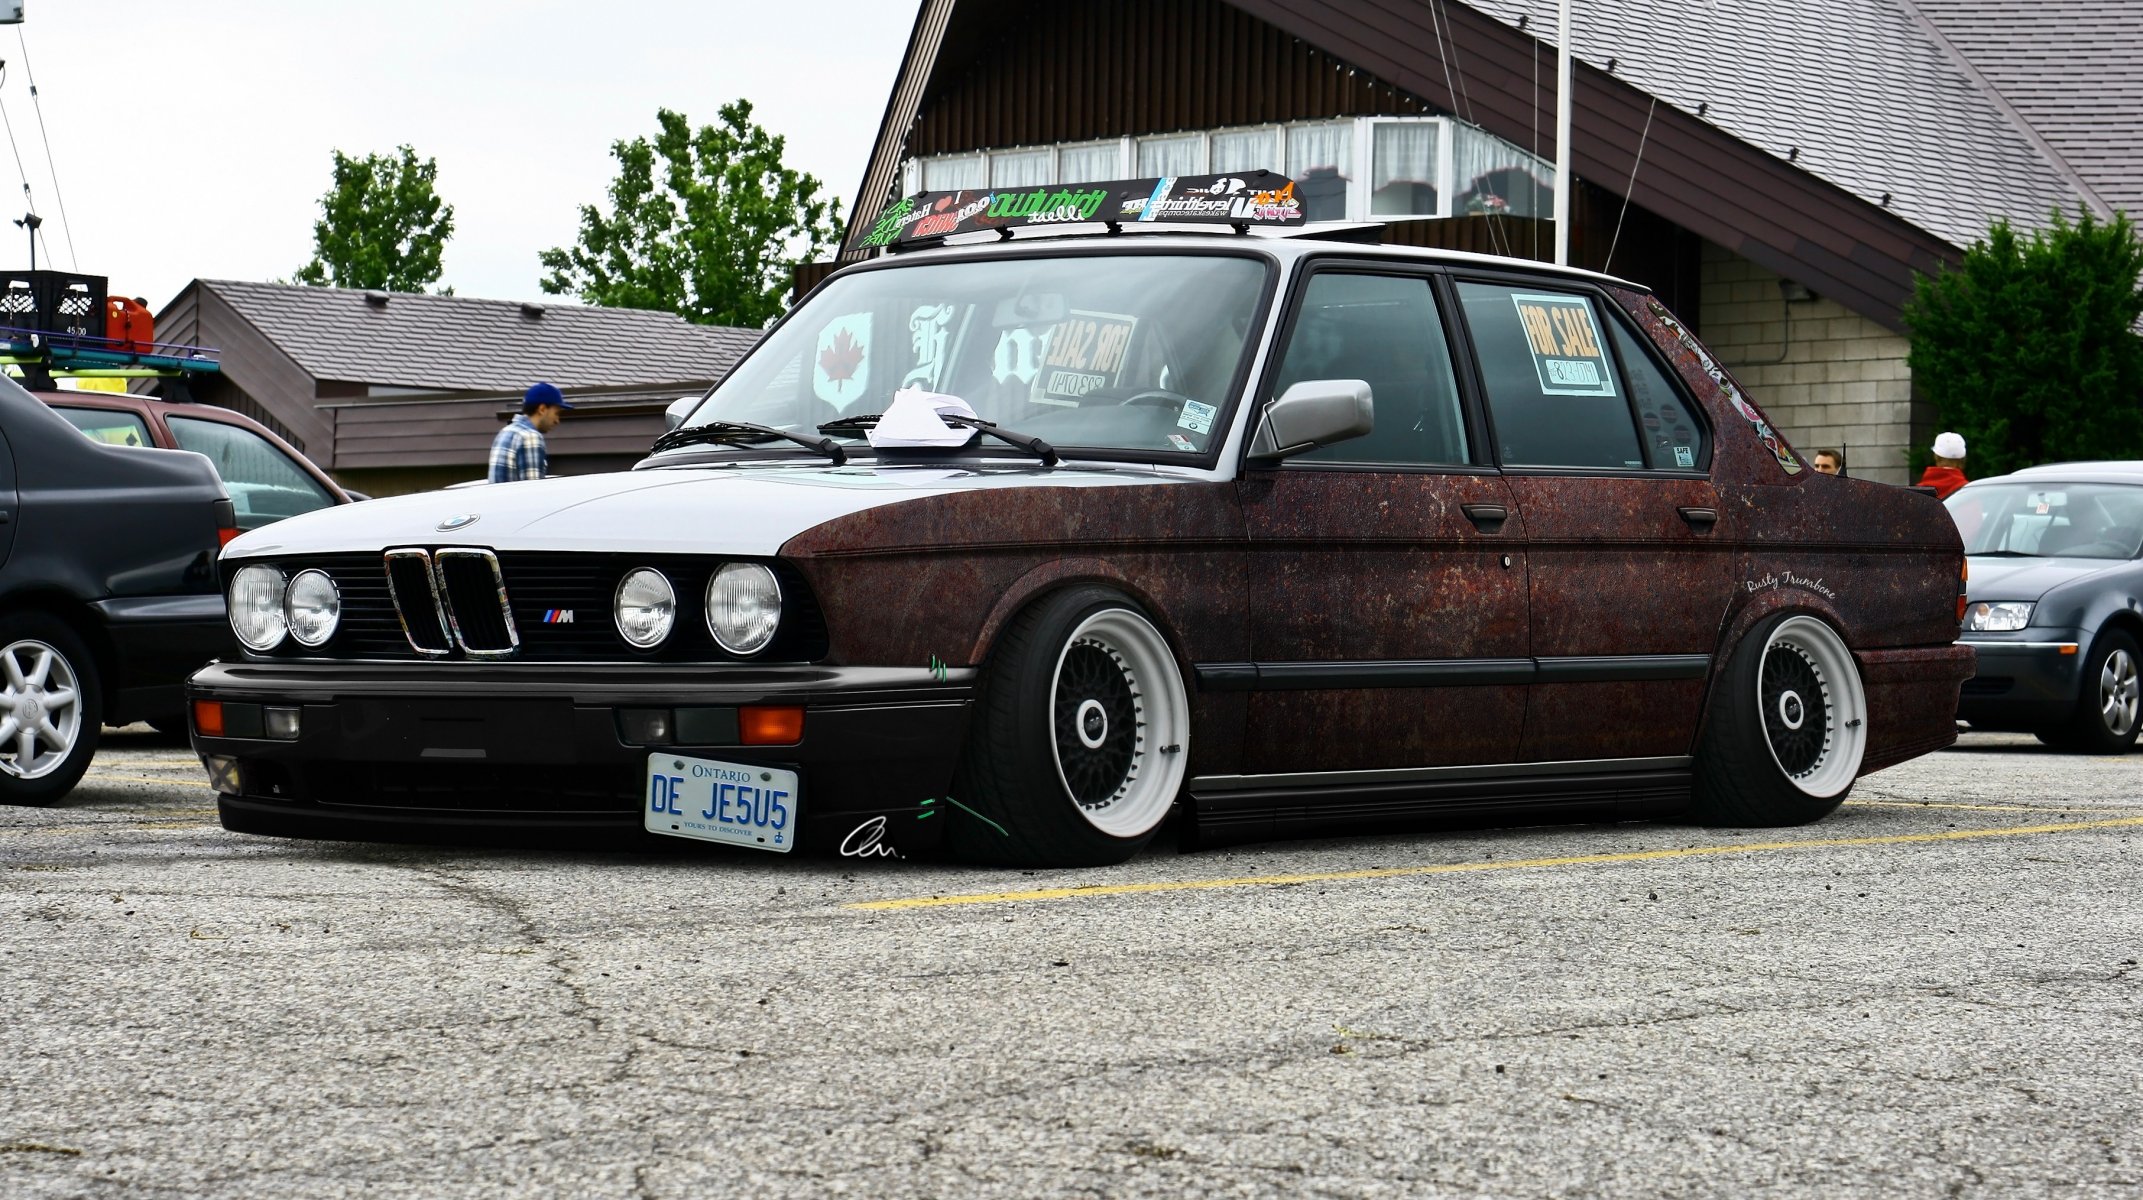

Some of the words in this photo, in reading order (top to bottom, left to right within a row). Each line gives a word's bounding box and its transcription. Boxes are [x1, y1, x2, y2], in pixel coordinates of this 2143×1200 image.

[1519, 305, 1561, 356] FOR
[1551, 306, 1600, 357] SALE
[1746, 572, 1779, 593] Rusty
[651, 774, 685, 816] DE
[684, 821, 706, 830] YOURS
[708, 824, 718, 832] TO
[719, 826, 752, 836] DISCOVER
